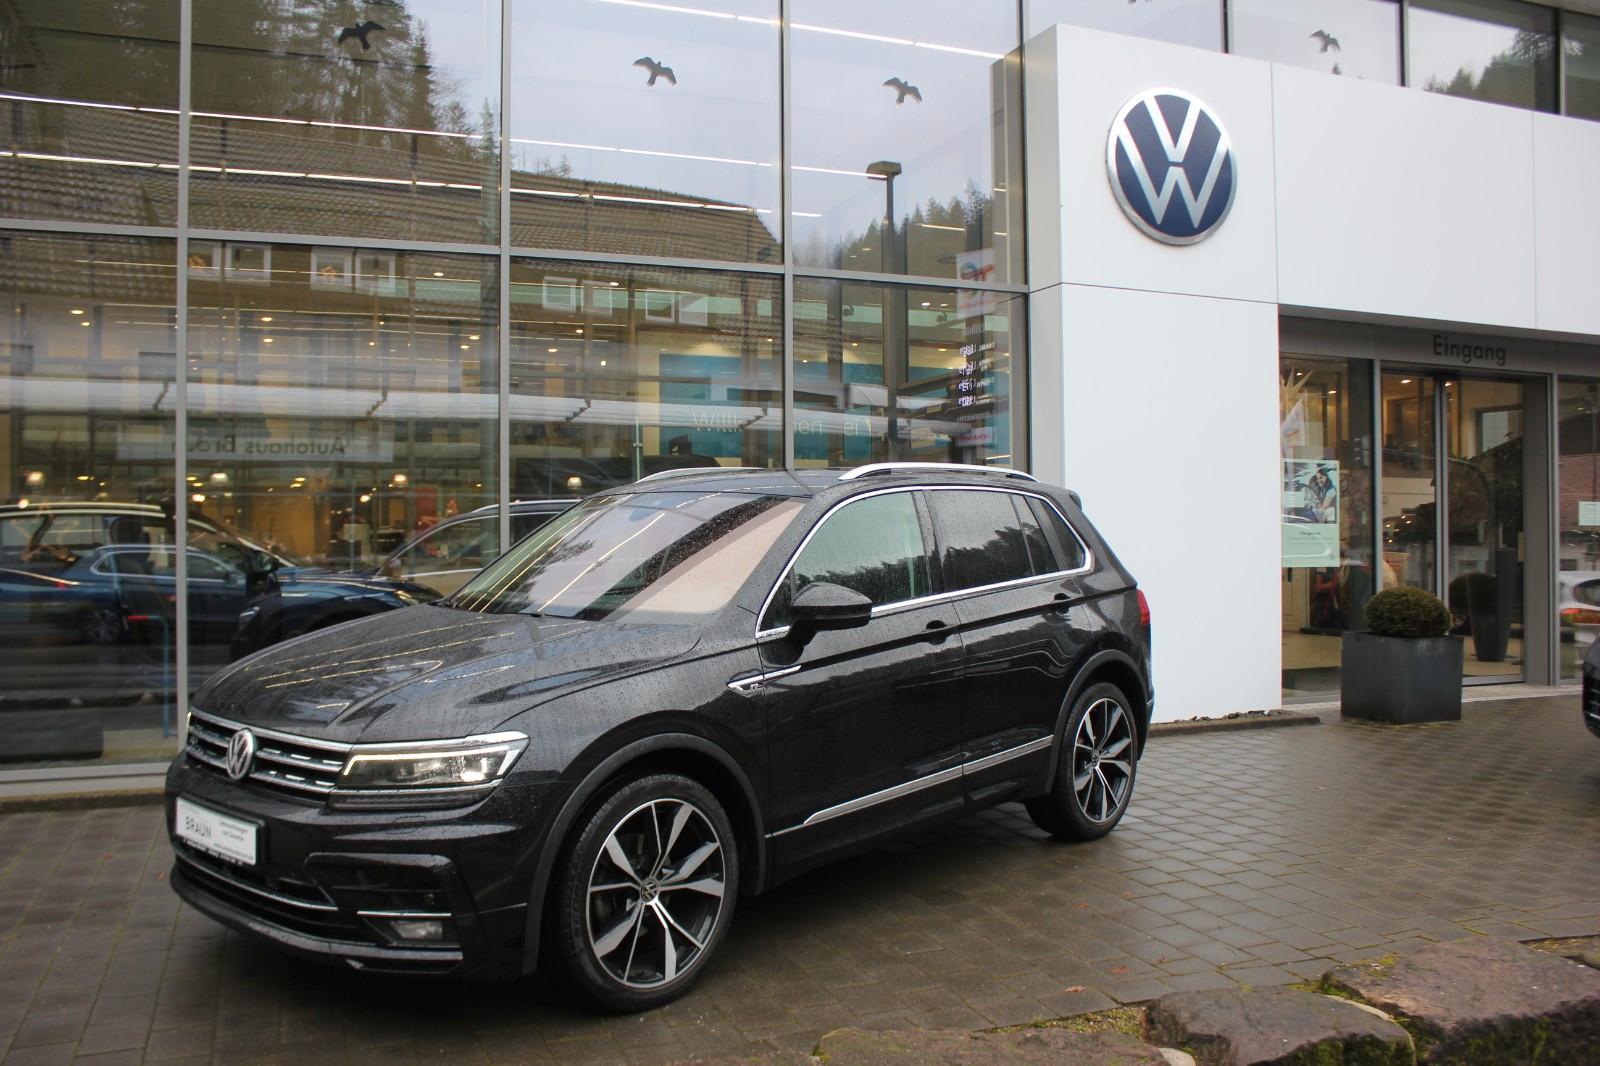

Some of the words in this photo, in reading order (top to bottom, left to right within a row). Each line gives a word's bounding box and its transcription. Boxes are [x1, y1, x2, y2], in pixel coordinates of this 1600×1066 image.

[1109, 87, 1235, 240] VW
[1433, 334, 1507, 367] Eingang
[226, 729, 254, 779] VW
[185, 815, 212, 839] BRAUN
